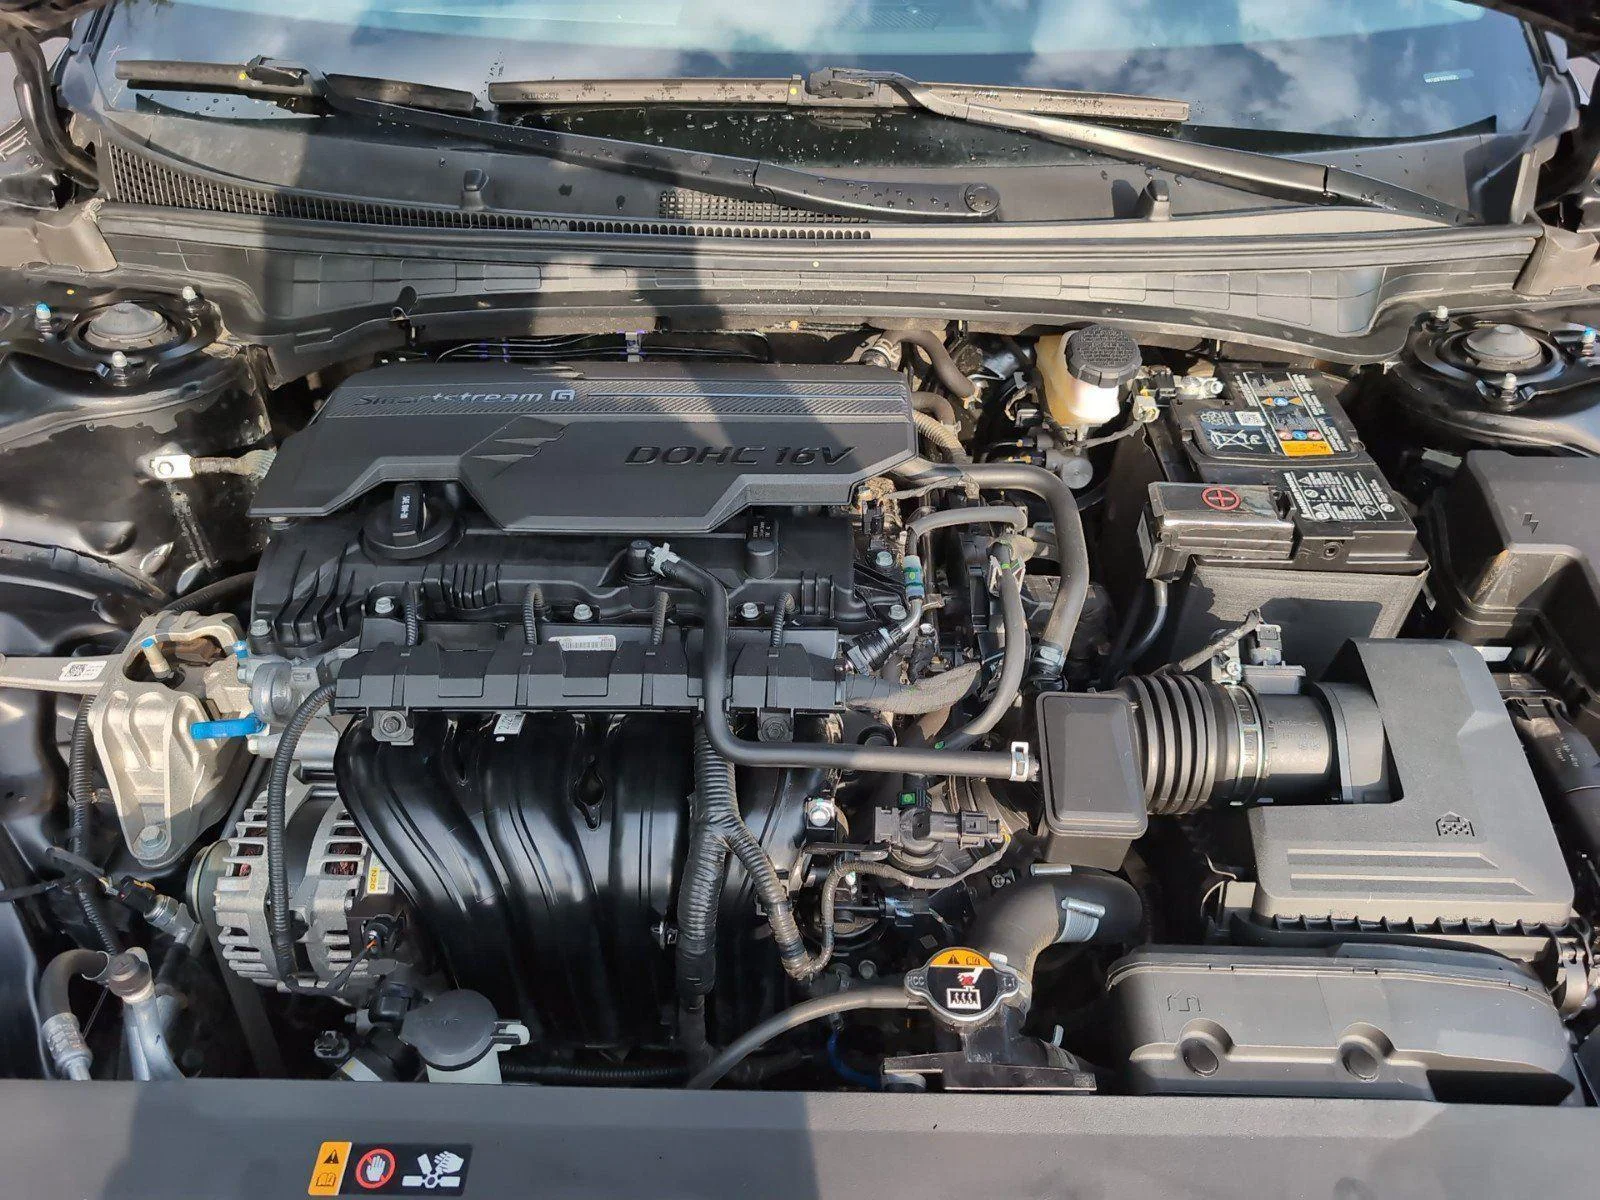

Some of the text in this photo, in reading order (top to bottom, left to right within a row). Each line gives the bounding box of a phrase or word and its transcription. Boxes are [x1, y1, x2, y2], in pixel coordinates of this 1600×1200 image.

[354, 392, 544, 406] Smartstream
[625, 446, 857, 466] DOHC 16V
